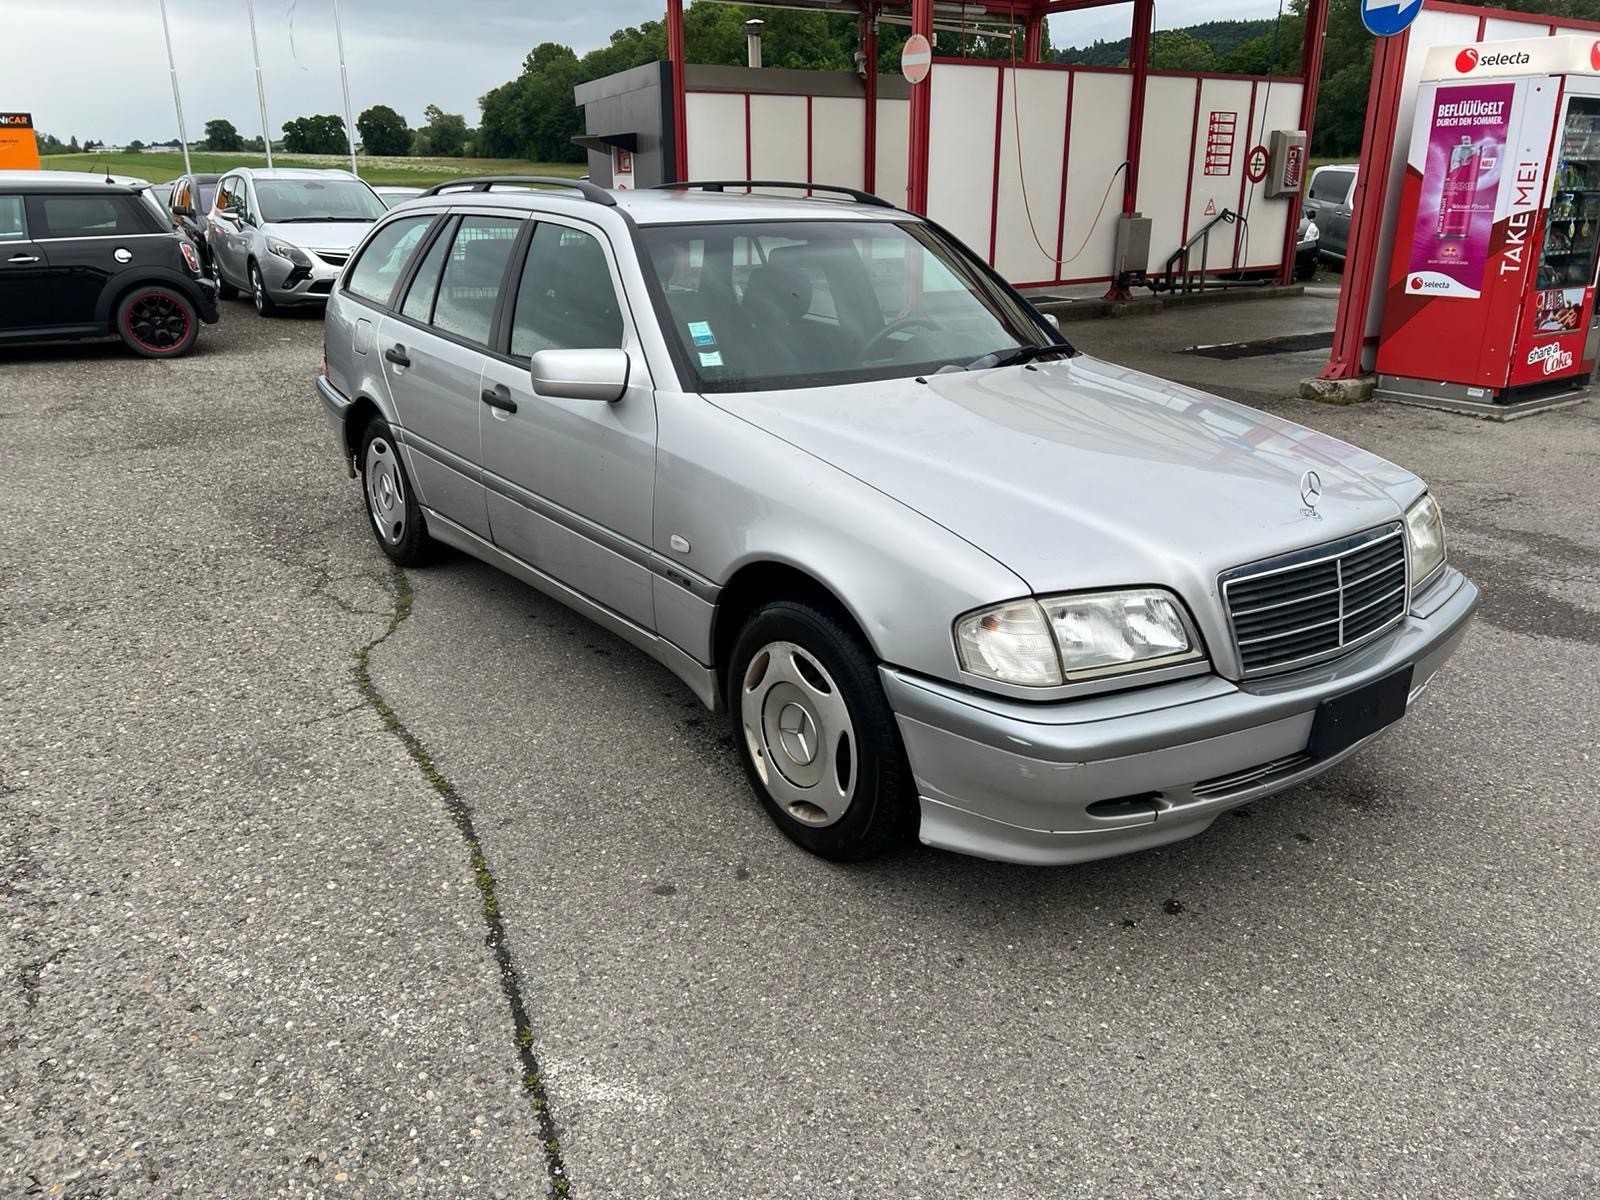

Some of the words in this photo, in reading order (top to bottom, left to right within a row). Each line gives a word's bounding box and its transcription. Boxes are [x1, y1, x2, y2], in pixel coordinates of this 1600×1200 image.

[1479, 51, 1530, 66] selecta
[1437, 100, 1504, 117] BEFLÜÜÜGELT
[1436, 118, 1458, 127] DURCH
[1459, 117, 1472, 126] DEN
[1473, 116, 1504, 125] SOMMER.
[1481, 160, 1493, 168] NEU
[1513, 162, 1538, 206] ME!
[1500, 213, 1529, 275] TAKE
[1424, 281, 1450, 289] selecta
[1529, 346, 1552, 362] share
[1552, 344, 1558, 353] a
[1544, 352, 1571, 373] Coke
